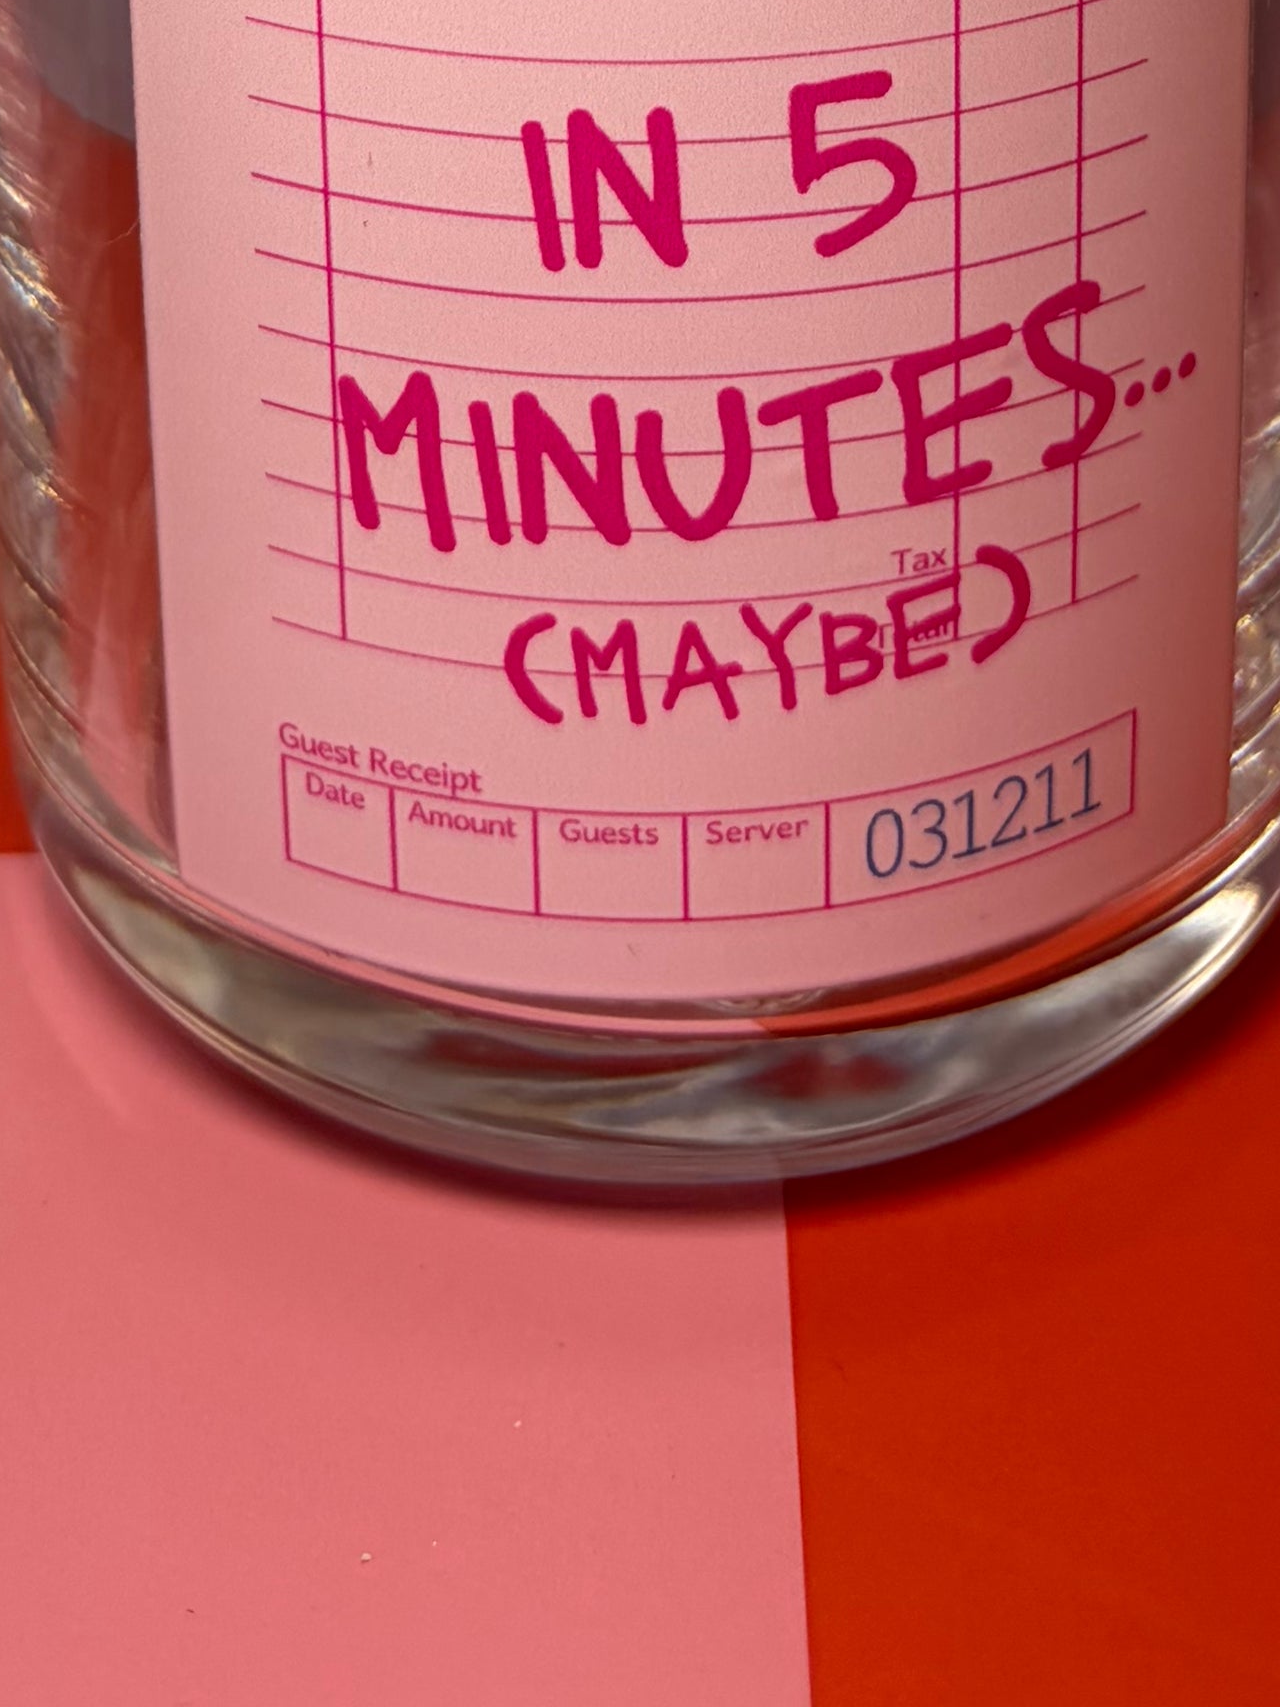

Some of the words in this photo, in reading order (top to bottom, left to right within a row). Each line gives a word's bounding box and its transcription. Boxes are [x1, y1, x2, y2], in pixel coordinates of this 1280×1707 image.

[520, 106, 689, 273] IN
[788, 70, 918, 257] 5
[891, 548, 947, 574] Tax
[503, 544, 1031, 726] (MAYBE)
[279, 722, 360, 769] Guest
[369, 747, 483, 795] Receipt
[306, 772, 366, 810] Date
[408, 800, 518, 840] Amount
[559, 818, 659, 846] Guests
[705, 815, 809, 846] Server
[864, 748, 1103, 881] 031211
